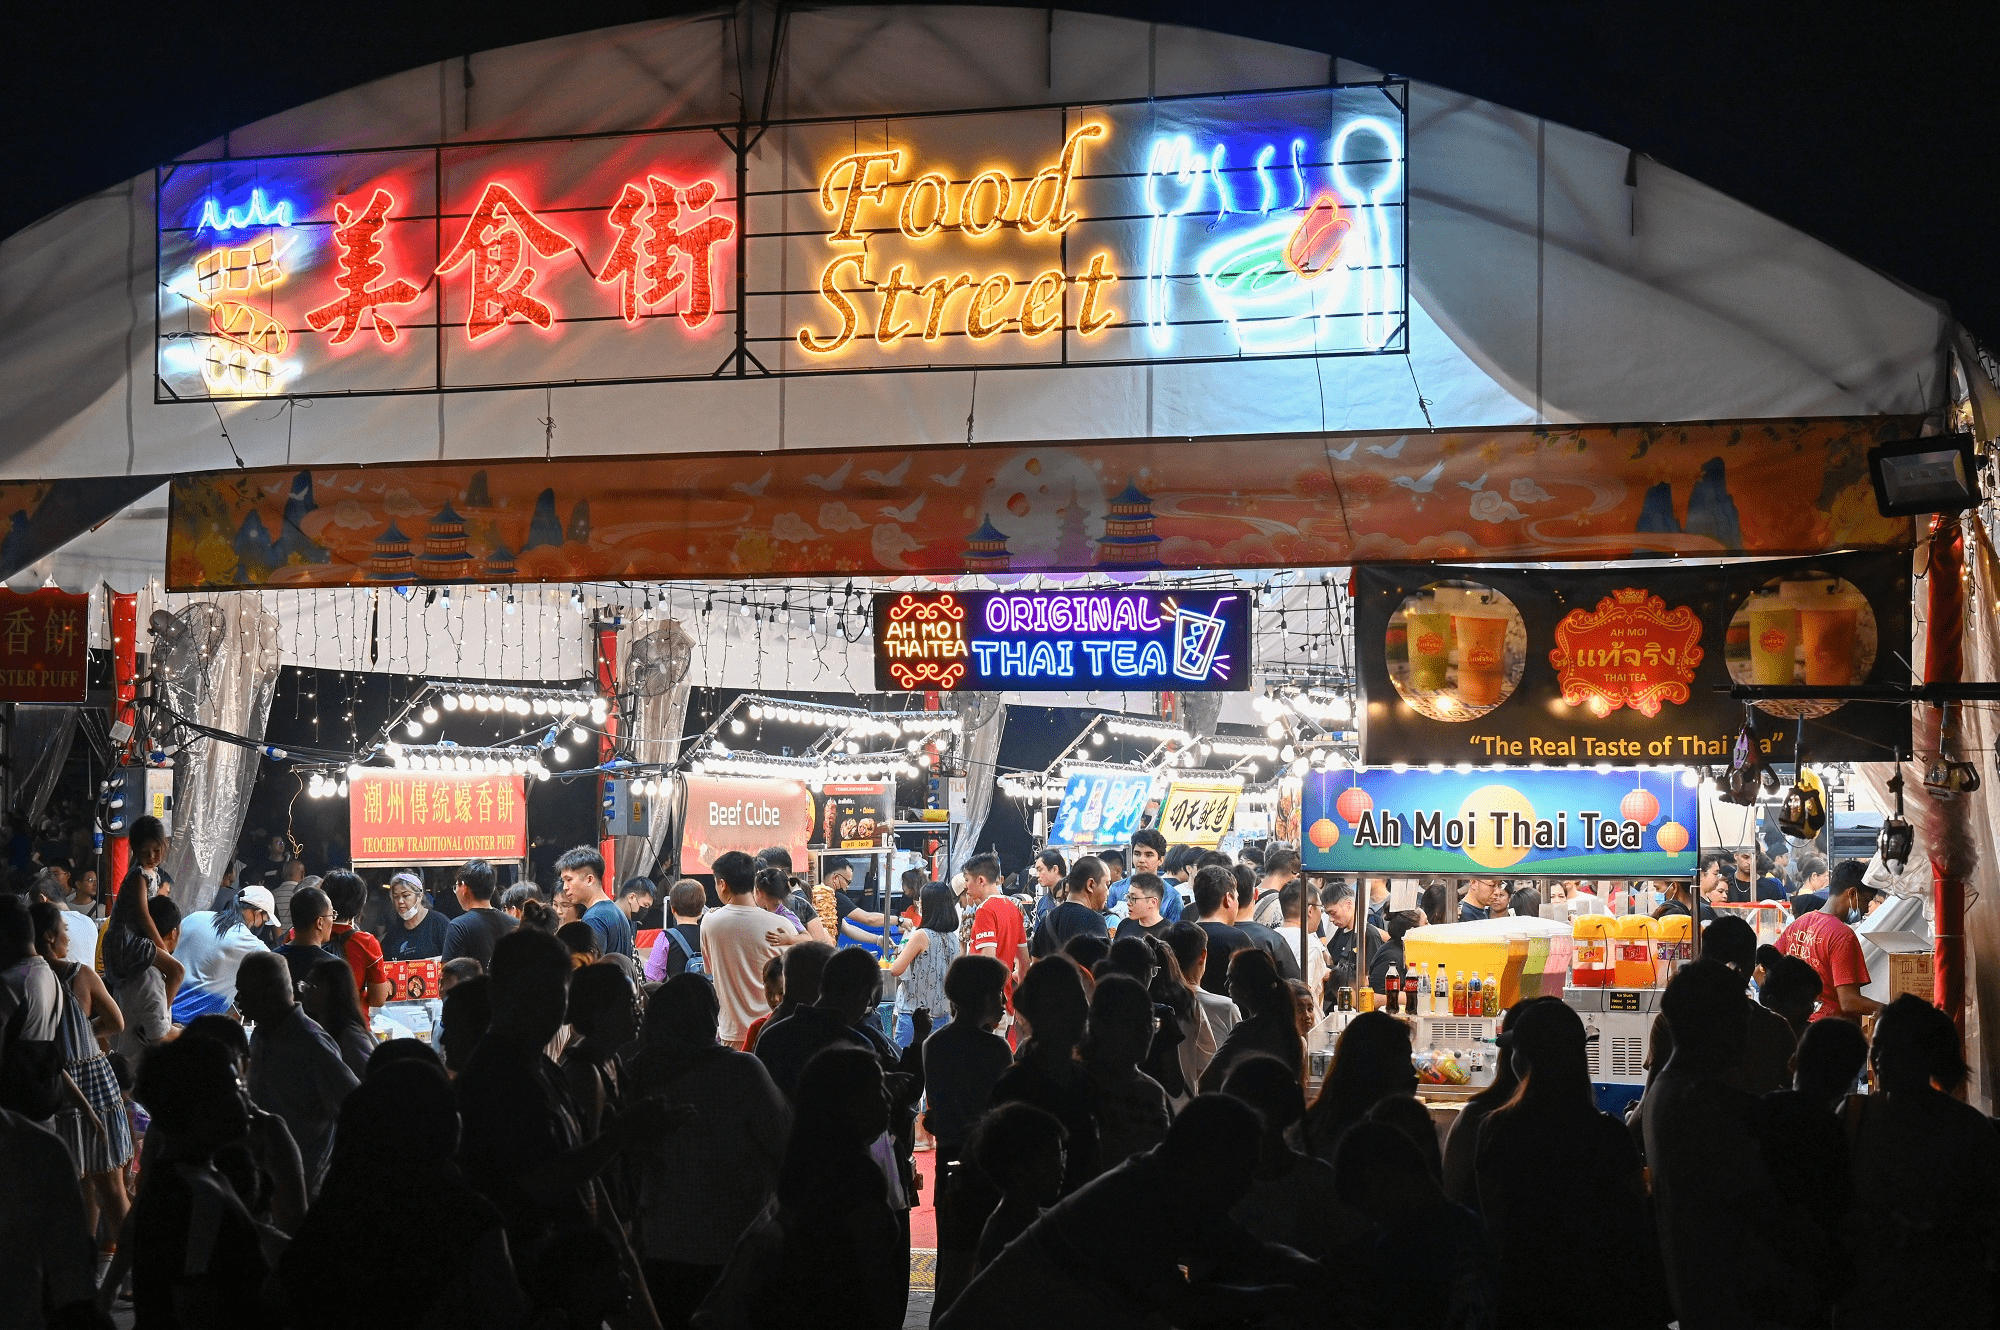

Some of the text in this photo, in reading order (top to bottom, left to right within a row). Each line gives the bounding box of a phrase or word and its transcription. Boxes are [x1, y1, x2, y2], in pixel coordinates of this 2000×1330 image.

[820, 124, 1106, 243] Food
[304, 174, 737, 345] 美食街
[797, 253, 1118, 354] Street
[985, 596, 1161, 632] ORIGINAL
[886, 621, 916, 639] AH
[1610, 628, 1648, 637] AH MOI
[971, 641, 1167, 676] THAI TEA
[1577, 641, 1676, 667] แท้จริง
[41, 669, 79, 687] PUFF
[1603, 673, 1648, 682] THAI TEA
[1529, 735, 1576, 756] Real
[1582, 736, 1642, 756] Taste
[1648, 735, 1673, 755] of
[1677, 735, 1727, 755] Thai
[363, 779, 515, 825] 潮州傳統蠔香餅
[709, 799, 780, 826] Beef Cube
[1354, 810, 1642, 850] Ah Moi Thai Tea
[362, 835, 516, 853] TEOCHEW TRADITIONAL OYSTER PUFF
